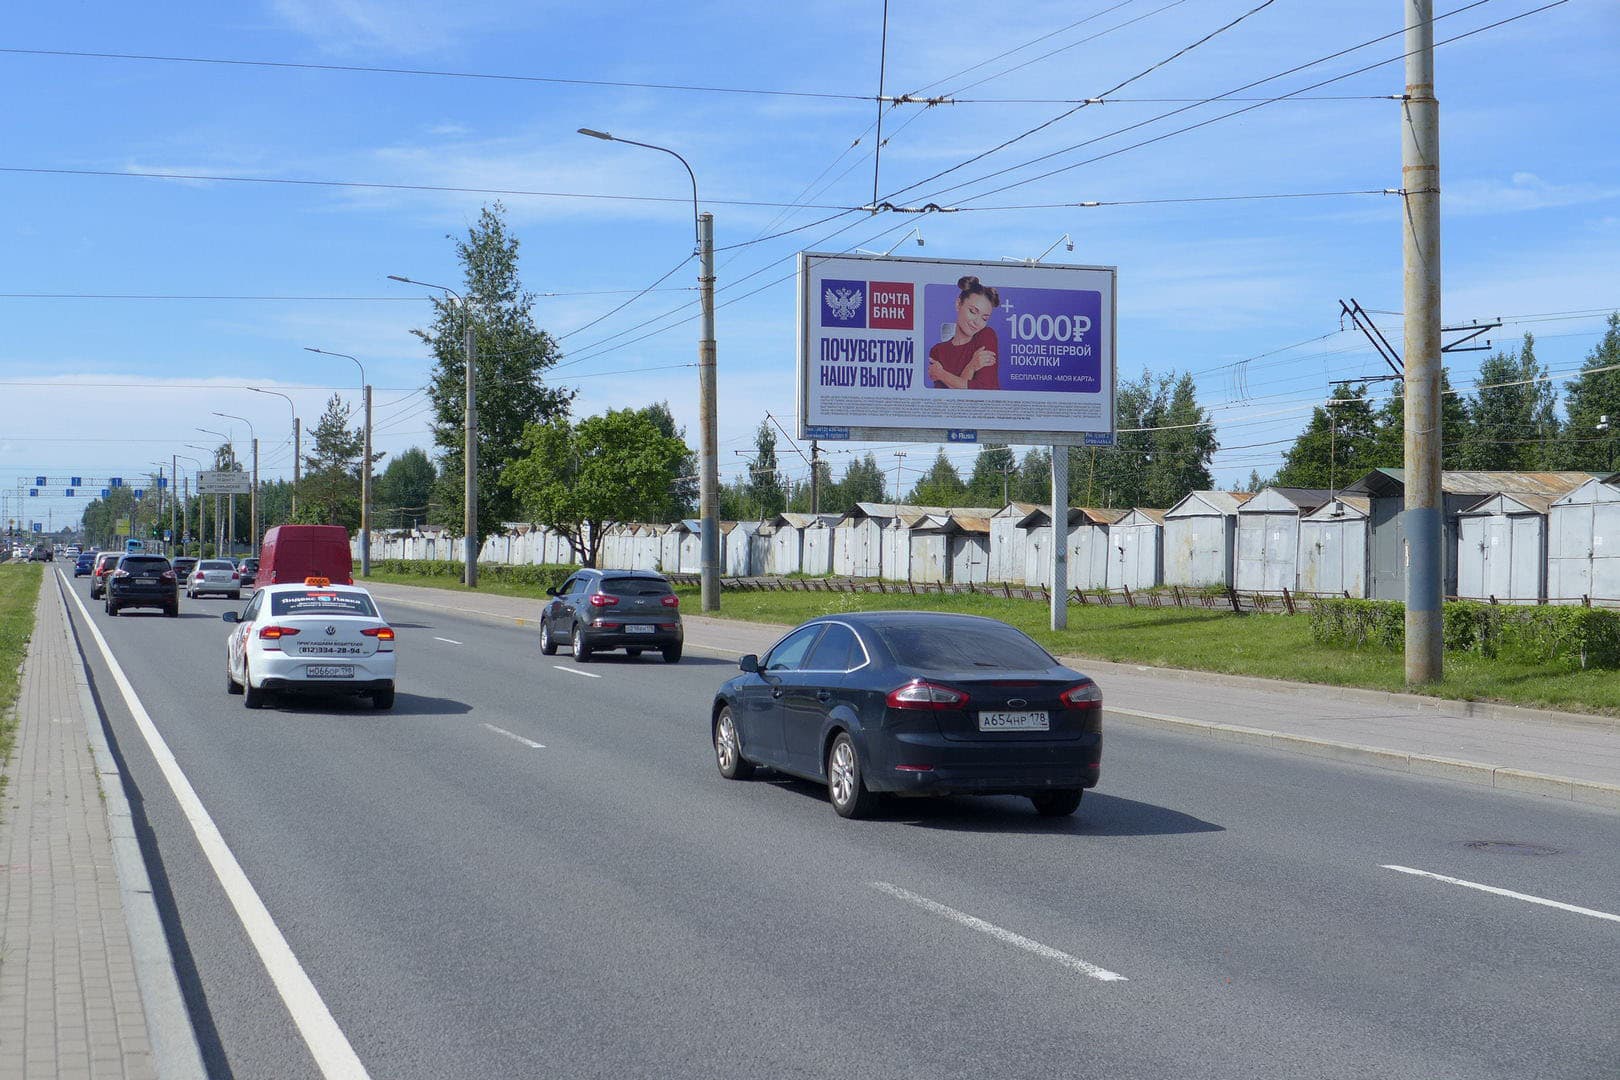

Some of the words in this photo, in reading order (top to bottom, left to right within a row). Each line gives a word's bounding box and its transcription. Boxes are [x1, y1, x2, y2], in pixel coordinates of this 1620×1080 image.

[873, 292, 910, 305] ПОЧТА
[873, 306, 905, 320] БАНК
[820, 337, 914, 364] ПОЧУВСТВУЙ
[1010, 344, 1047, 355] ПОСЛЕ
[1049, 344, 1091, 356] ПЕРВОЙ
[1010, 355, 1060, 367] ПОКУПКИ
[820, 365, 858, 387] НАШУ
[860, 366, 914, 391] ВЫГОДУ
[1010, 373, 1053, 381] БЕСПЛАТНАЯ
